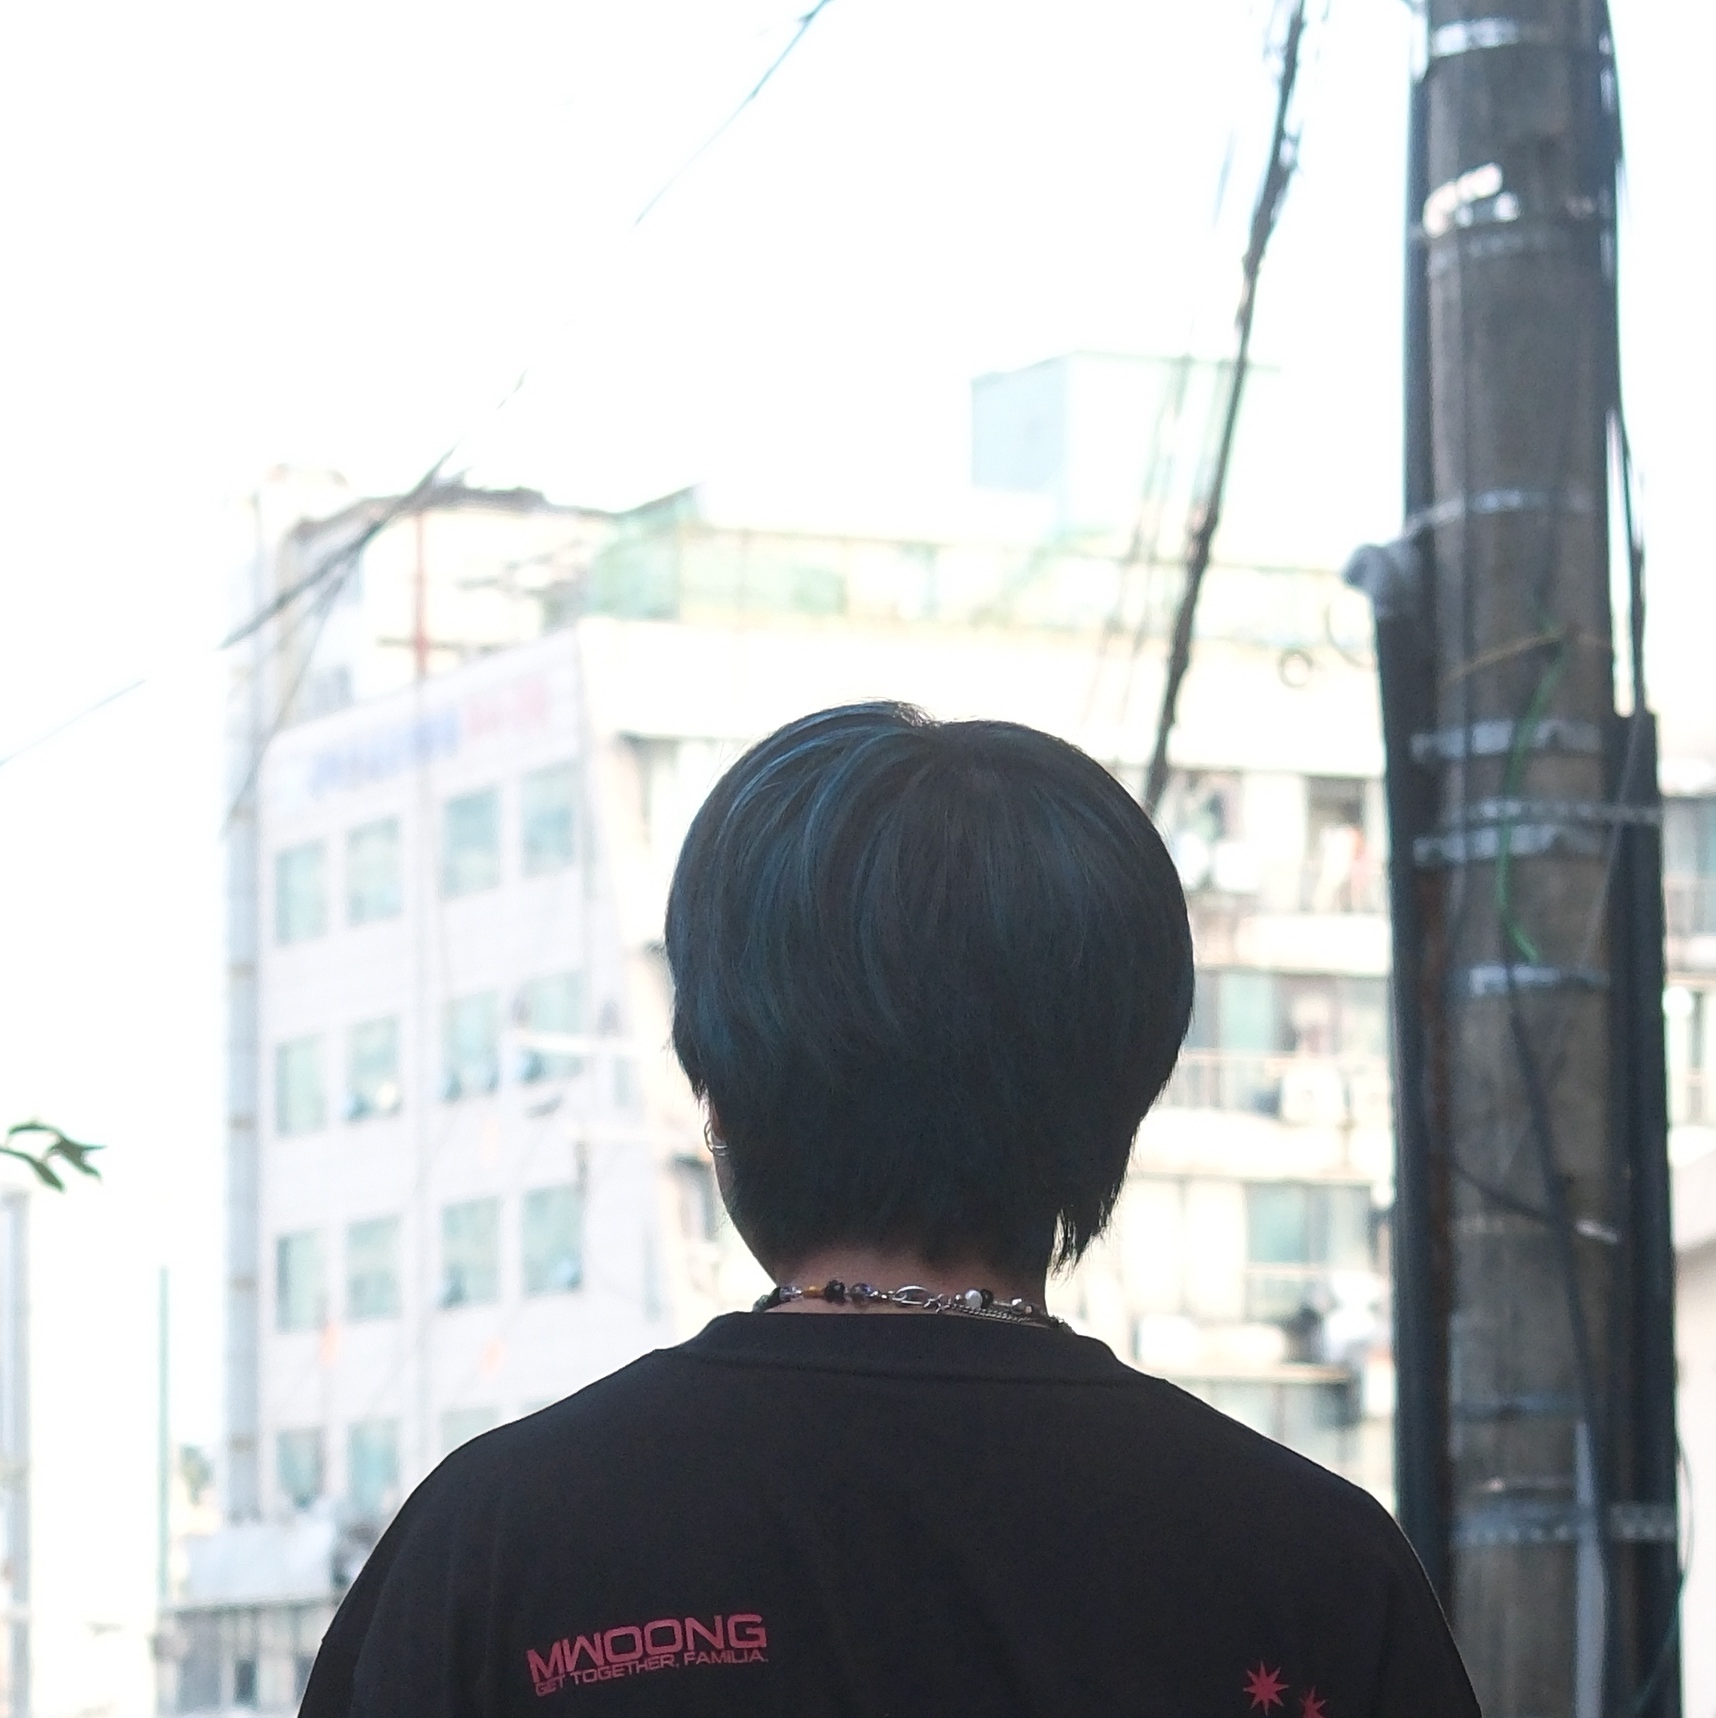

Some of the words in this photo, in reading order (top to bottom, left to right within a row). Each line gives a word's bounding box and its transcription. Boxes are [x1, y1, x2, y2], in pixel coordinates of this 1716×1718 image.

[526, 1612, 768, 1684] MWOONG
[534, 1674, 568, 1698] GET
[570, 1654, 680, 1686] TOGETHER,
[684, 1647, 769, 1667] FAMILIA.
